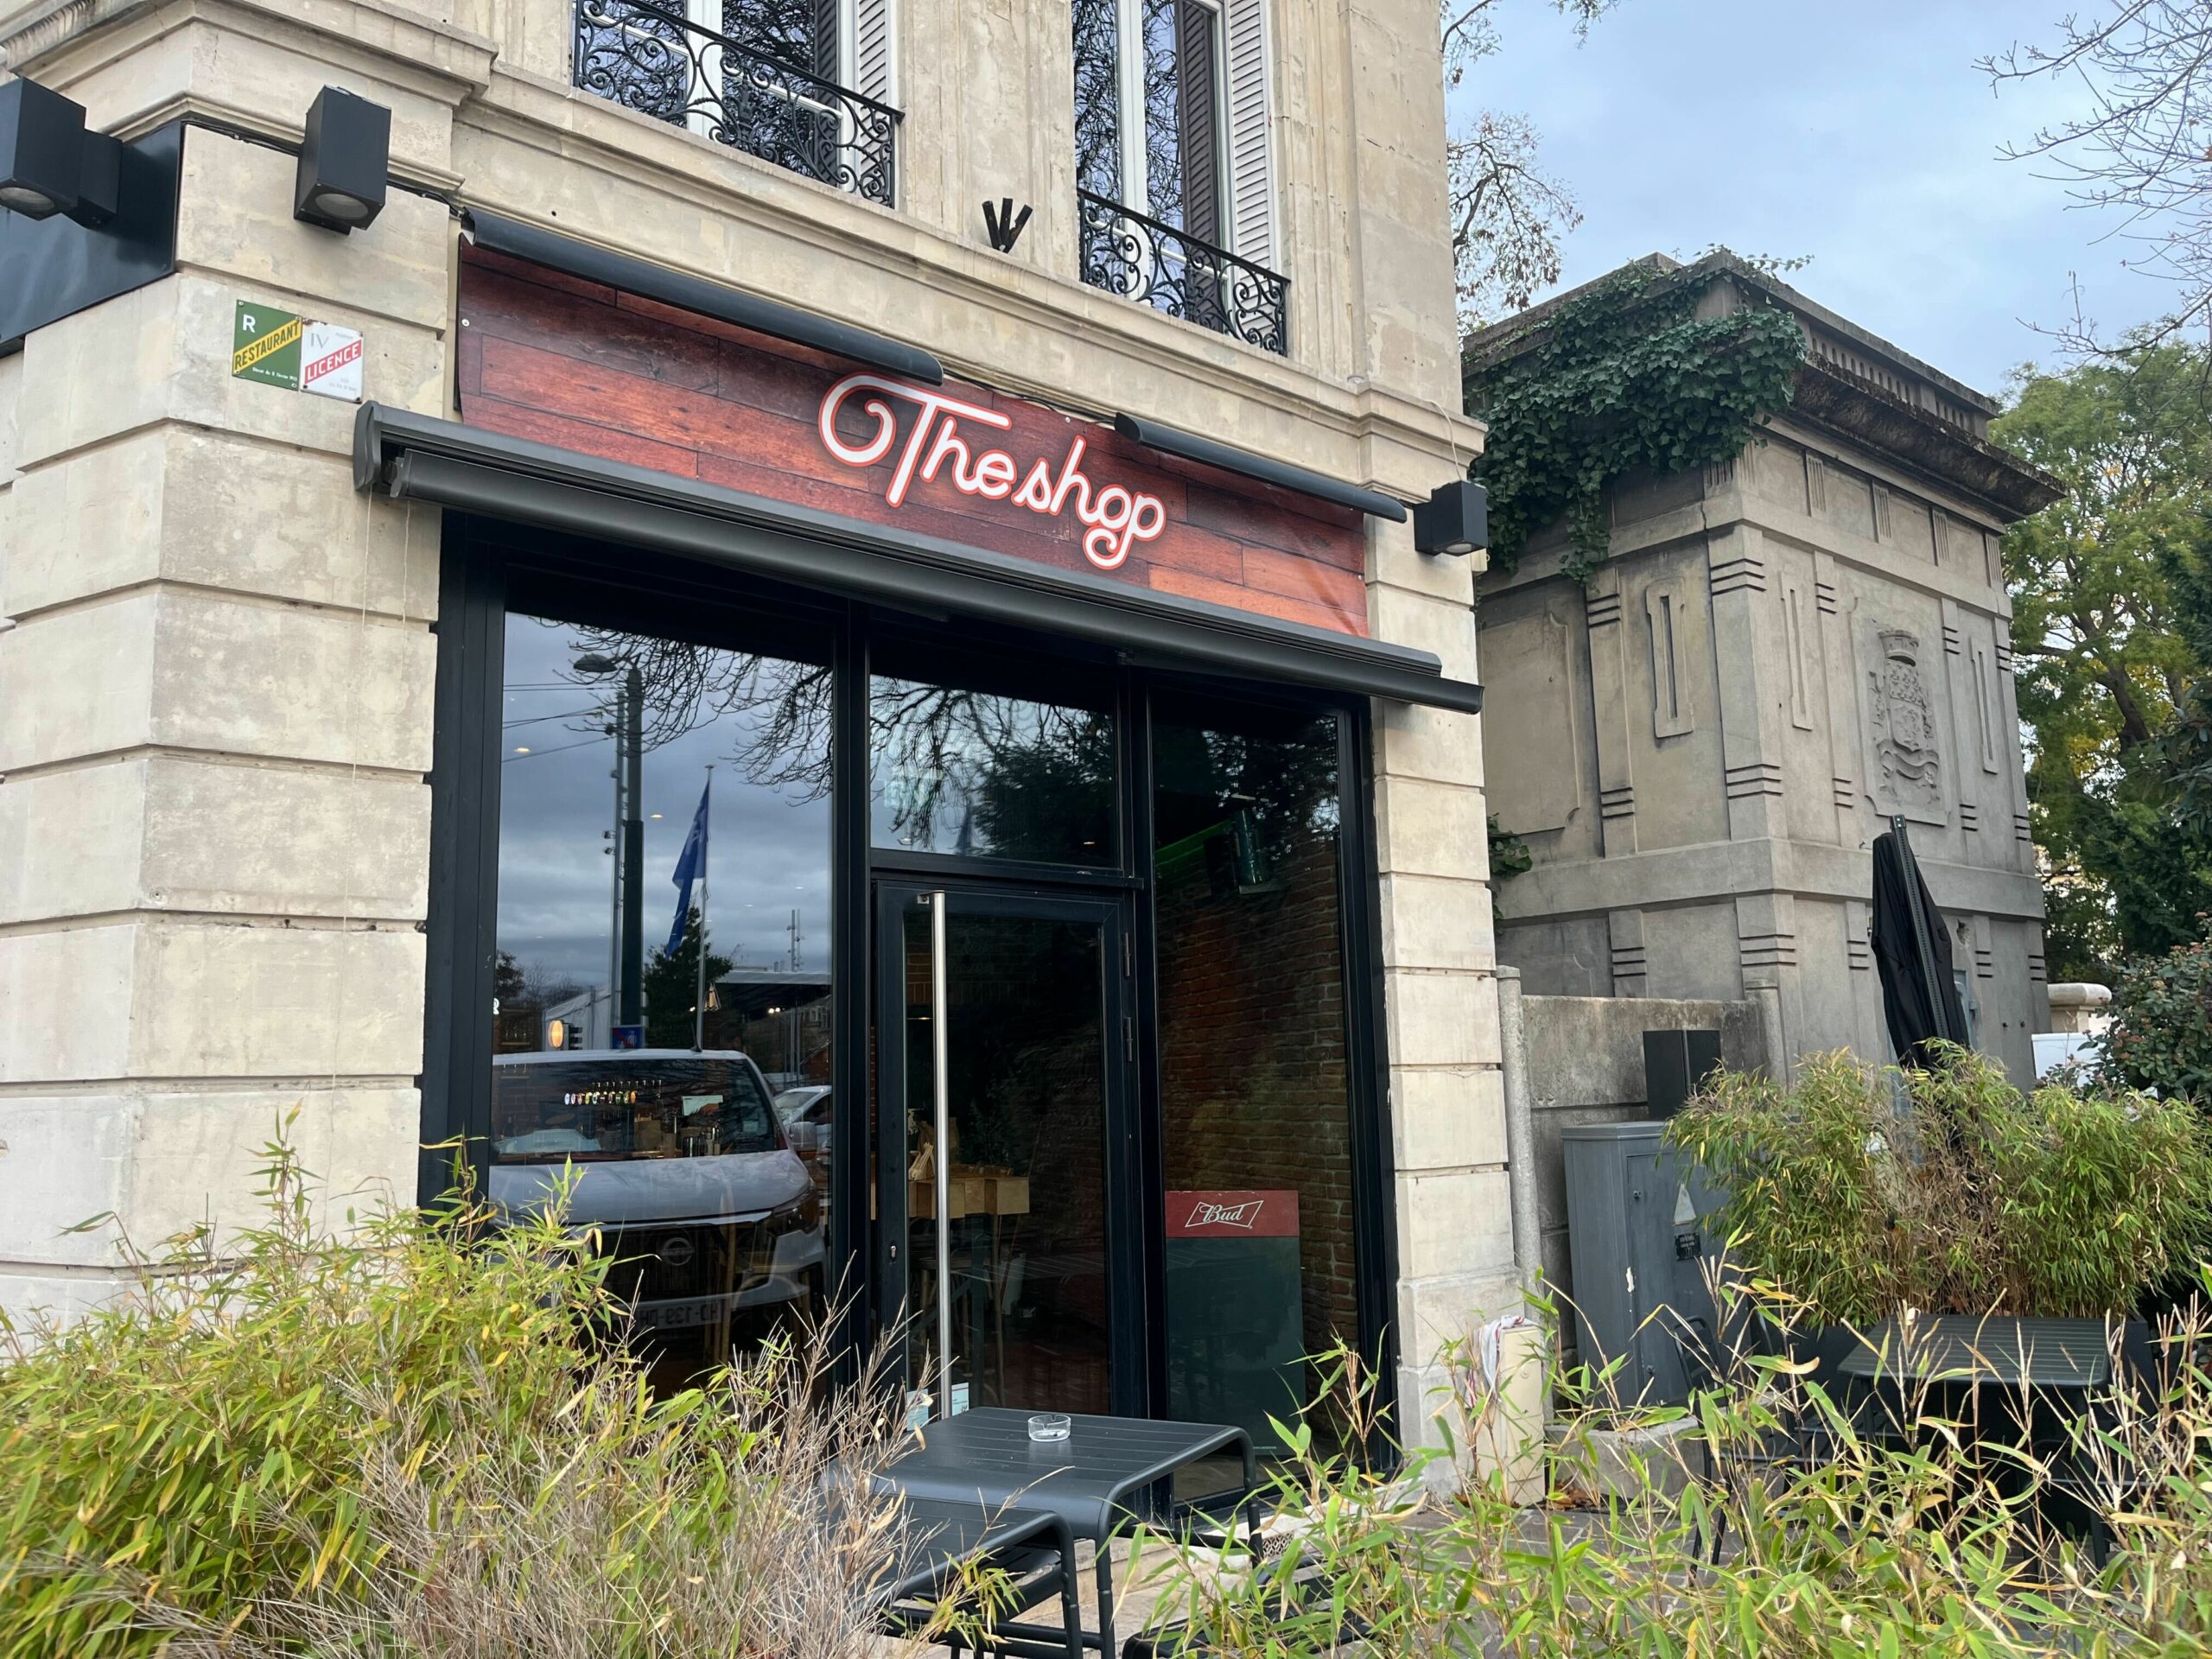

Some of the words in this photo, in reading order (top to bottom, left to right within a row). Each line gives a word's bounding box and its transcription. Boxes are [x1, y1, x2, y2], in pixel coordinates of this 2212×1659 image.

[242, 314, 256, 333] R
[234, 321, 300, 370] RESTAURANT
[311, 333, 329, 349] IV
[307, 342, 359, 381] LICENCE
[1198, 1204, 1245, 1224] Bud
